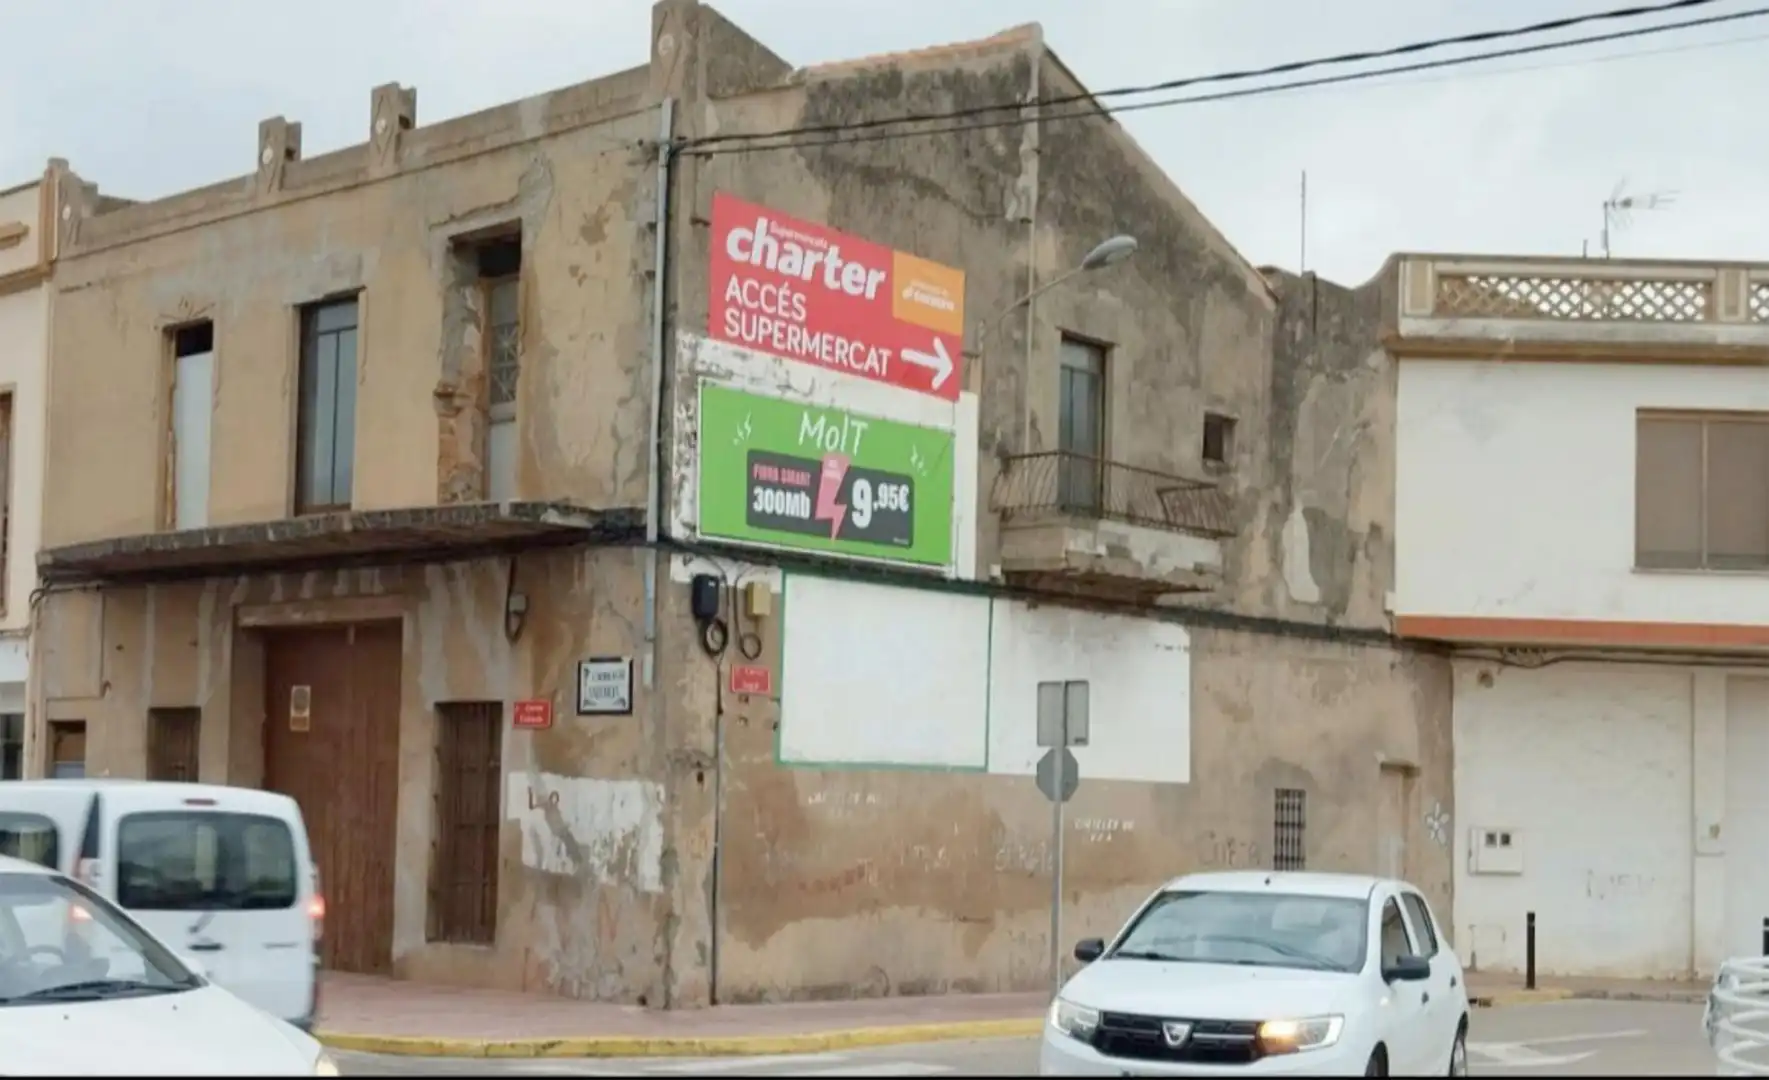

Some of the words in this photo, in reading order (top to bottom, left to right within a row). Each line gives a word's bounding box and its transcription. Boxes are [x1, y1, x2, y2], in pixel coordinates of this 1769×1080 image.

[726, 217, 886, 300] charter
[725, 273, 806, 322] ACCÉS
[724, 307, 892, 377] SUPERMERCAT
[753, 485, 811, 520] 300Mb
